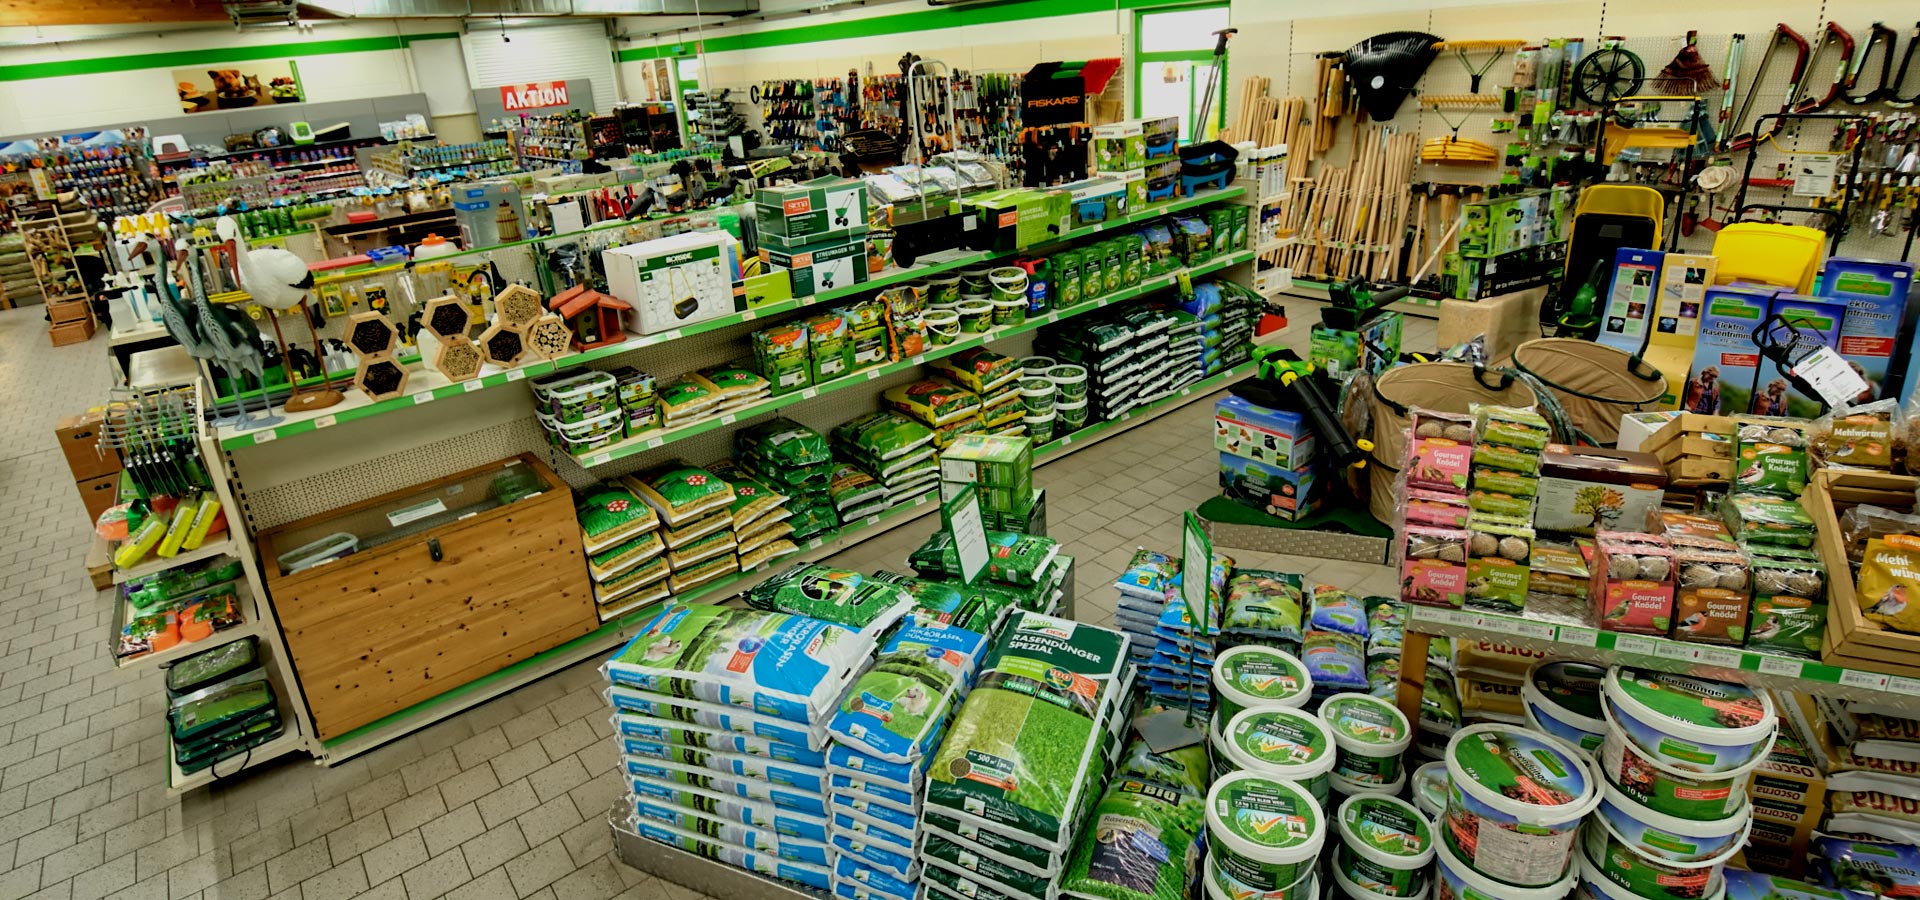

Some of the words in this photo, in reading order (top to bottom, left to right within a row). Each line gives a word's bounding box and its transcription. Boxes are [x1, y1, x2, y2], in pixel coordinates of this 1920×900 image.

[506, 87, 568, 109] AKTION
[1028, 96, 1080, 108] FISKARS
[1849, 301, 1880, 309] ektro-
[1847, 310, 1892, 321] ntrimmer
[1702, 328, 1752, 340] Rasentrimm
[1834, 427, 1887, 438] Mehlwürmer
[1434, 450, 1464, 460] Gourmet
[1436, 457, 1460, 467] Knödel
[1765, 456, 1800, 467] Gourmet
[1768, 464, 1796, 474] Knödel
[1428, 570, 1459, 581] Gourmet
[1490, 569, 1522, 580] Gourmet
[1430, 577, 1455, 586] Knödel
[1492, 576, 1518, 587] Knödel
[1632, 593, 1666, 603] Gourmet
[1634, 601, 1661, 609] Knödel
[1707, 601, 1742, 611] Gourmet
[1709, 609, 1737, 619] Knödel
[1008, 641, 1053, 655] SPEZIAL
[1012, 634, 1102, 663] RASENDÜNGER
[1479, 641, 1545, 659] corna
[1050, 668, 1071, 681] 100
[1655, 673, 1728, 698] Eisendünger
[977, 754, 990, 762] 500
[1764, 762, 1815, 778] Oscor
[1143, 786, 1177, 801] BIO
[1626, 786, 1636, 796] 10
[1637, 792, 1648, 803] kg
[1757, 786, 1800, 801] Oscorna
[986, 808, 1020, 823] RASENDÜNGER
[1754, 807, 1798, 822] Oscorna
[1750, 829, 1788, 843] Oscorn
[1852, 859, 1917, 877] Bittersalz
[1610, 871, 1619, 880] 10
[1620, 878, 1631, 888] kg
